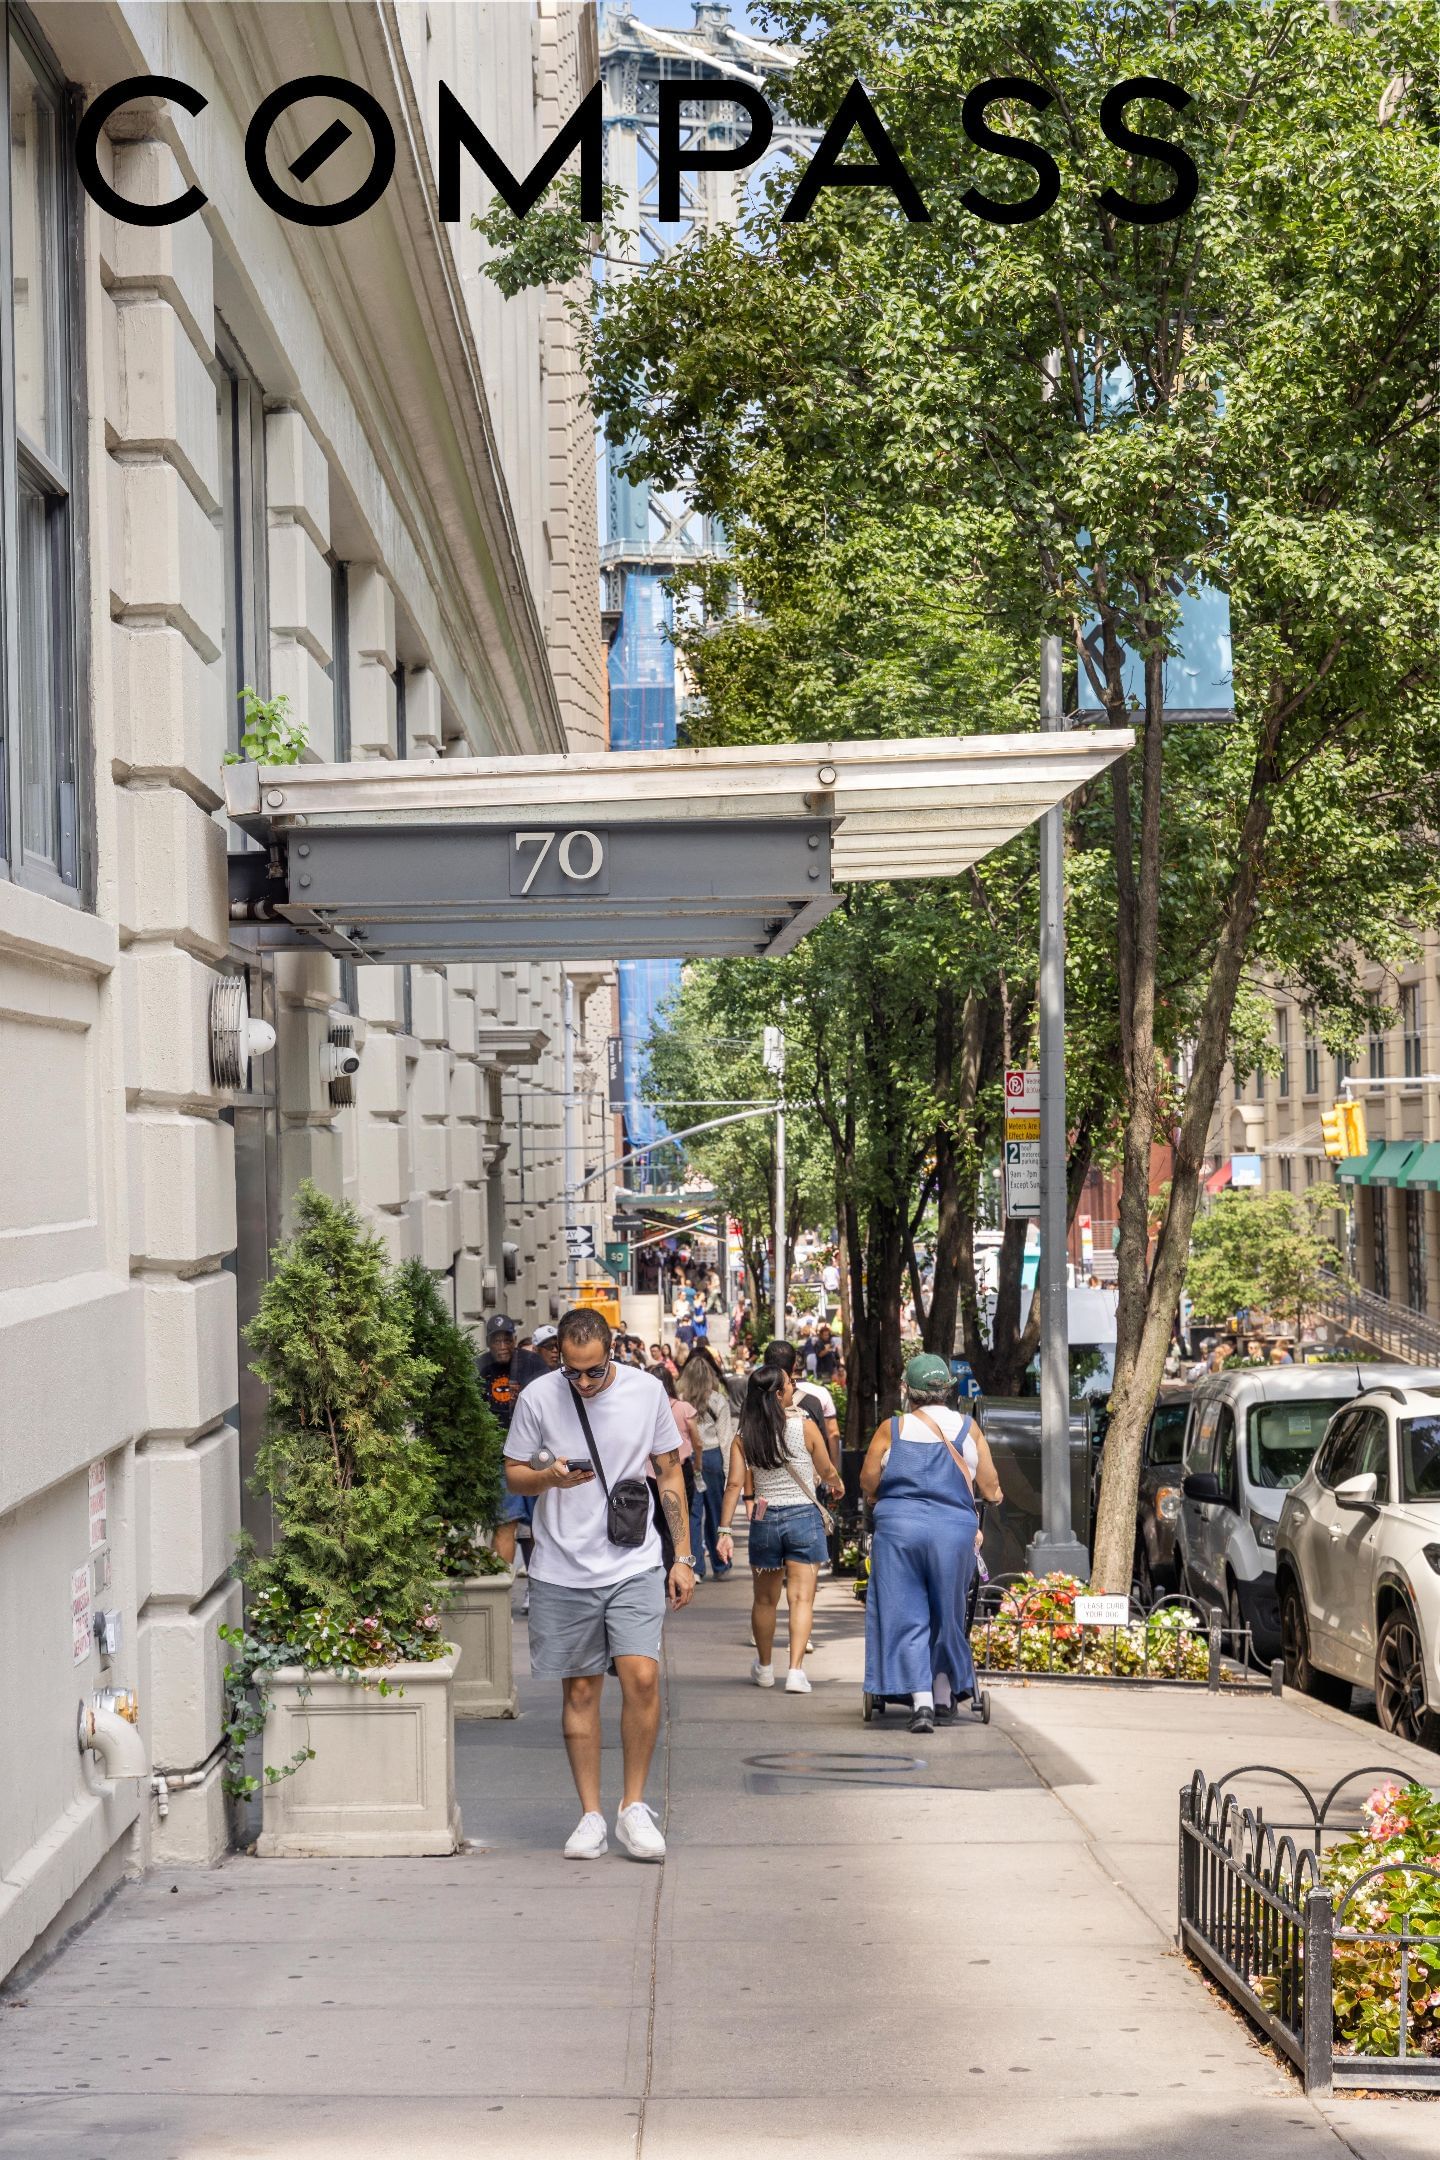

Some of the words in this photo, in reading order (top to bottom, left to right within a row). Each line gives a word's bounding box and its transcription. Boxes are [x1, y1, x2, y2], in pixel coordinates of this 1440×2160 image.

[516, 830, 603, 894] 70
[1008, 1122, 1027, 1130] Meters
[1028, 1122, 1038, 1130] Are
[1008, 1132, 1024, 1140] Effect
[1009, 1143, 1019, 1163] 2
[1010, 1170, 1022, 1178] 9am
[1027, 1170, 1038, 1179] 7pm
[1010, 1180, 1029, 1189] Except
[1029, 1180, 1040, 1189] Sun
[611, 1252, 624, 1263] sg
